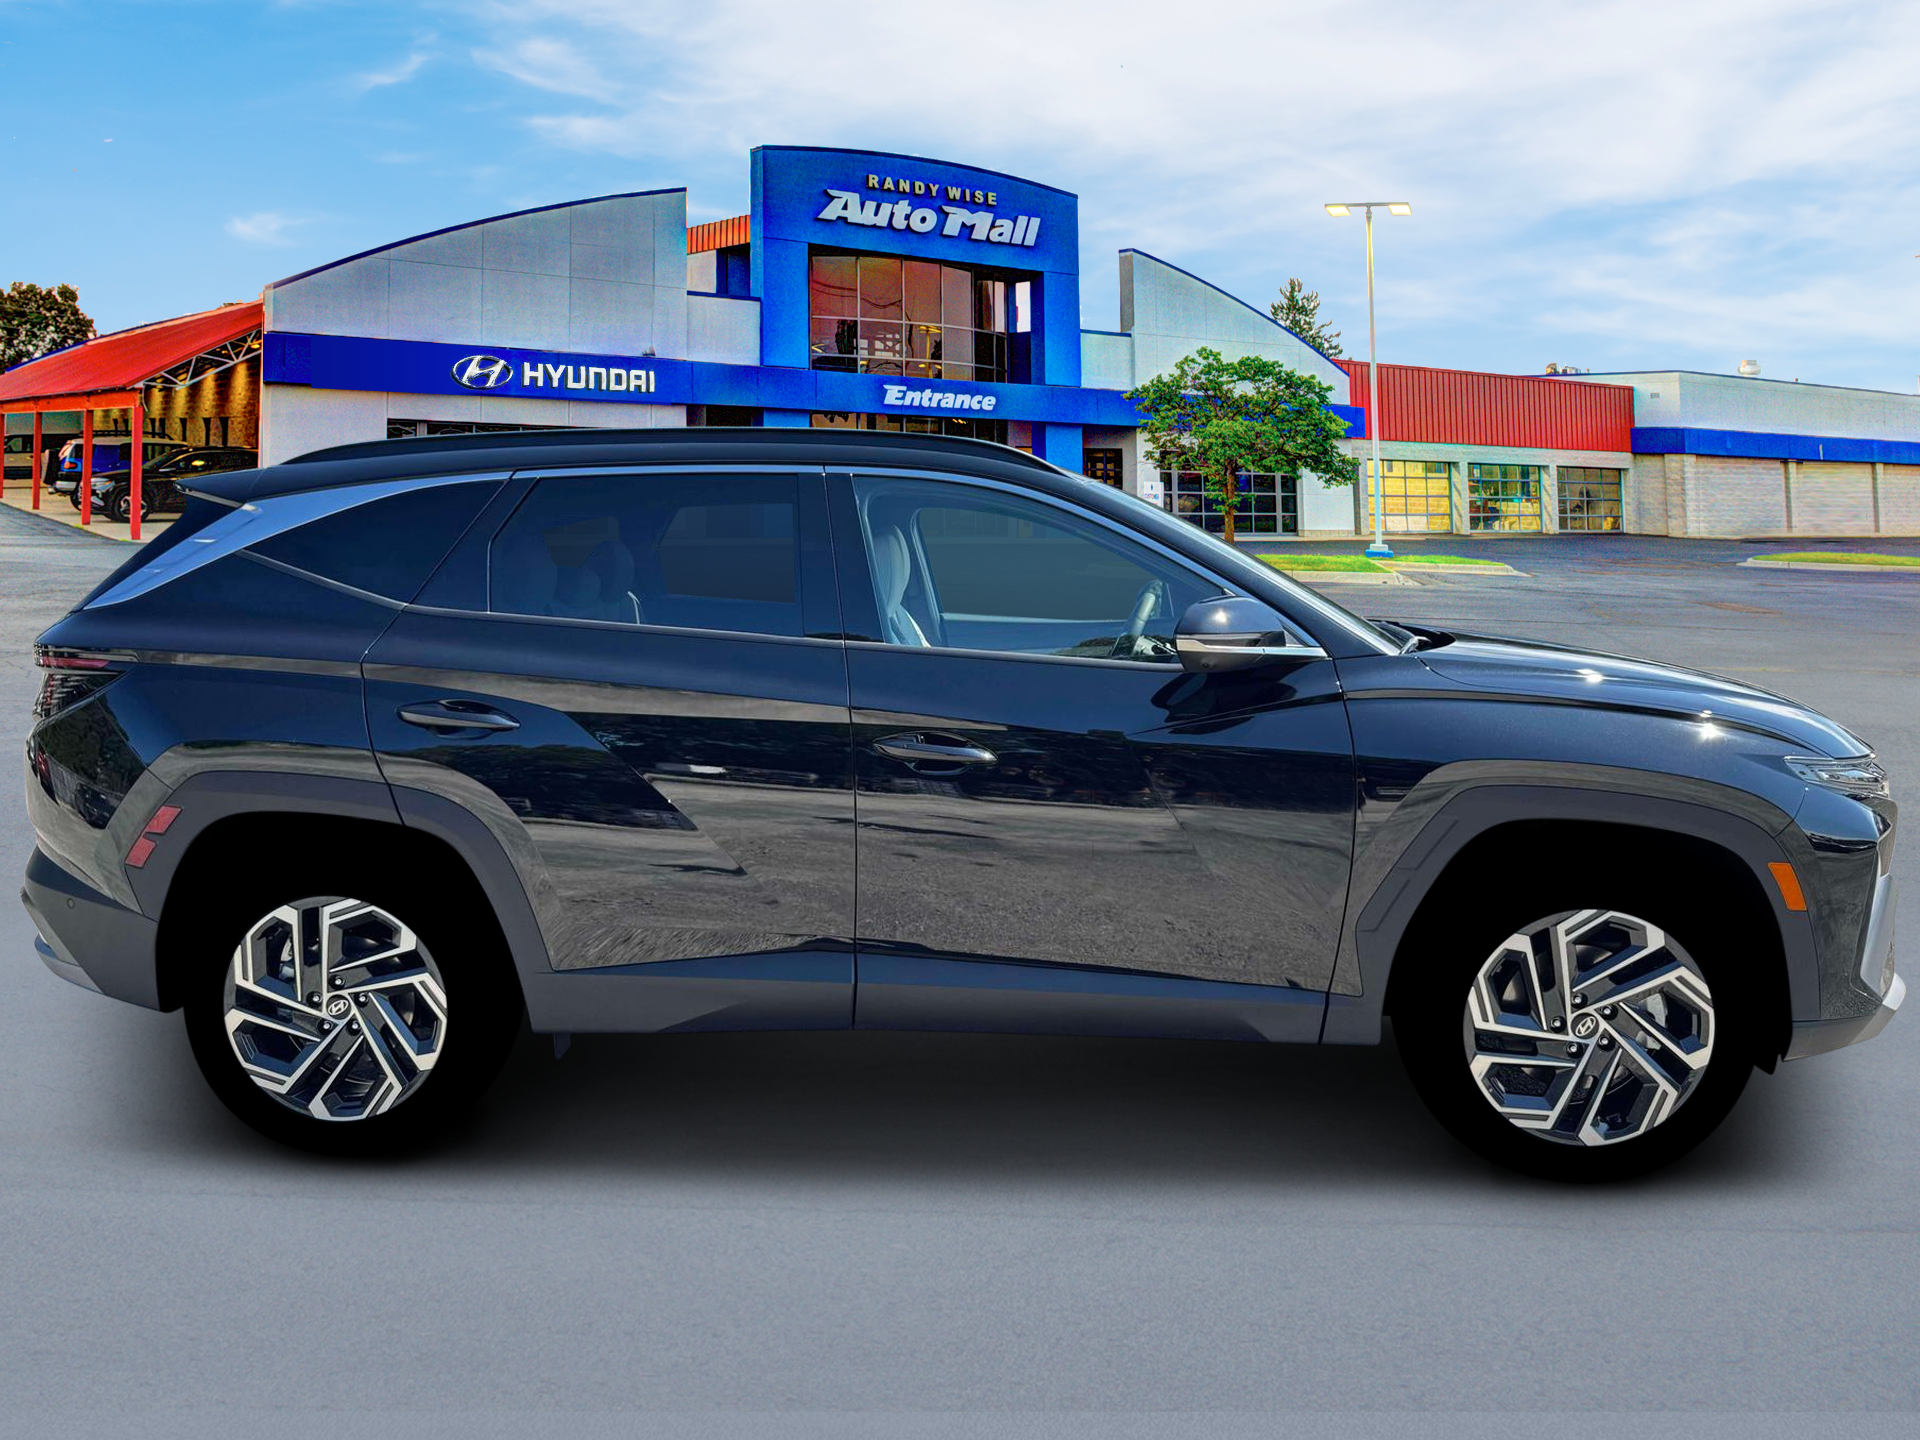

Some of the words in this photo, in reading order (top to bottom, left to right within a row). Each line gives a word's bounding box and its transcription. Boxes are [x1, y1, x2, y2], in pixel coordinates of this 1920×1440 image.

[867, 173, 940, 197] RANDY
[946, 185, 998, 206] WISE
[816, 189, 938, 233] Auto
[941, 205, 1041, 246] Mall
[522, 362, 656, 393] HYUNDAI
[883, 384, 997, 411] Entrance
